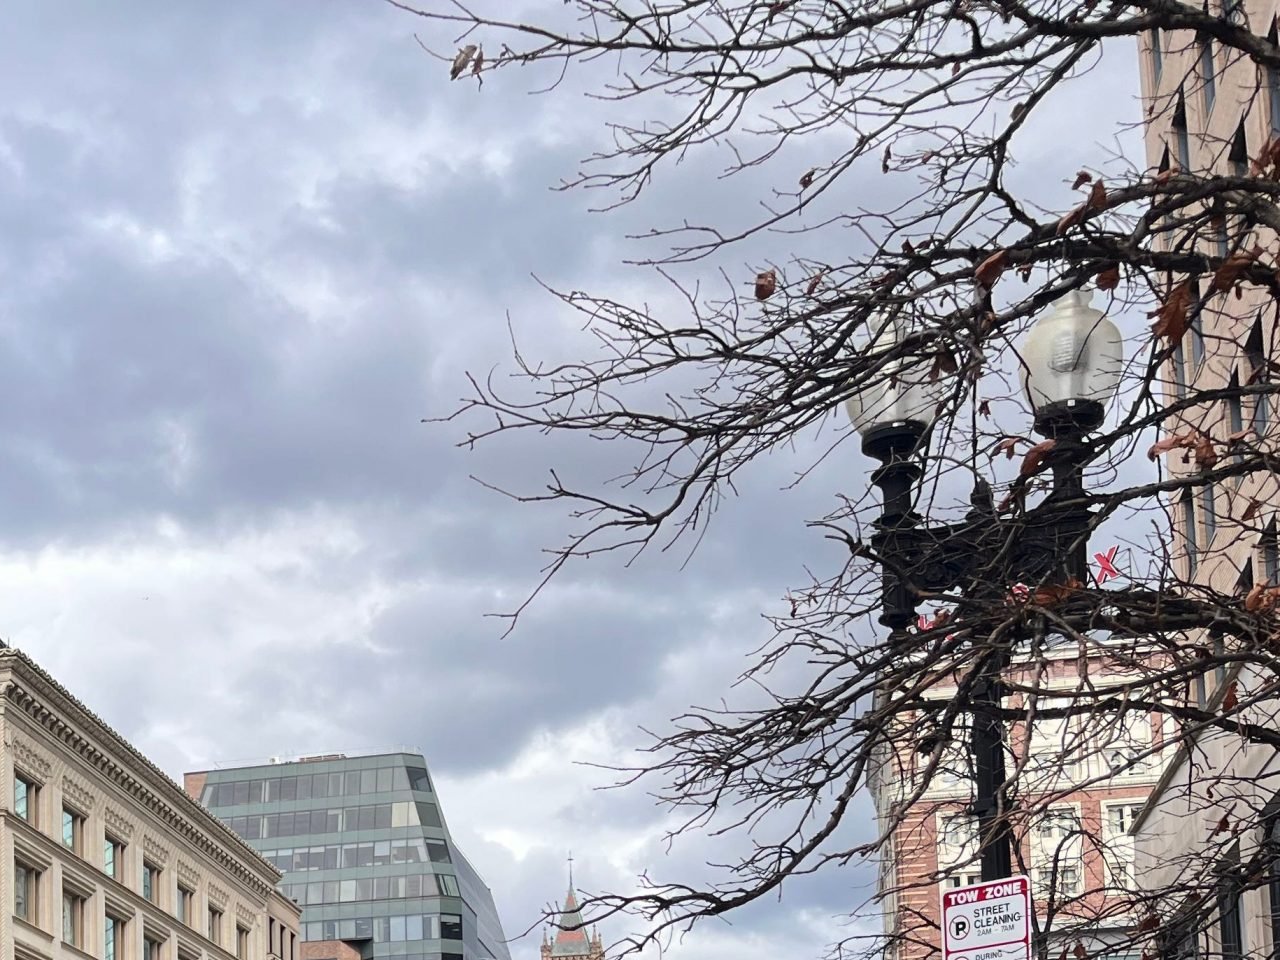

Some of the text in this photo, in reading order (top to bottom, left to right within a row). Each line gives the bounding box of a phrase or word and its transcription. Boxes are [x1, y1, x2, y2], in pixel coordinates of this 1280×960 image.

[948, 882, 1022, 906] TOW ZONE
[973, 903, 1010, 918] STREET
[973, 912, 1021, 929] CLEANING
[977, 928, 992, 936] 2AM
[1001, 924, 1015, 932] 7AM
